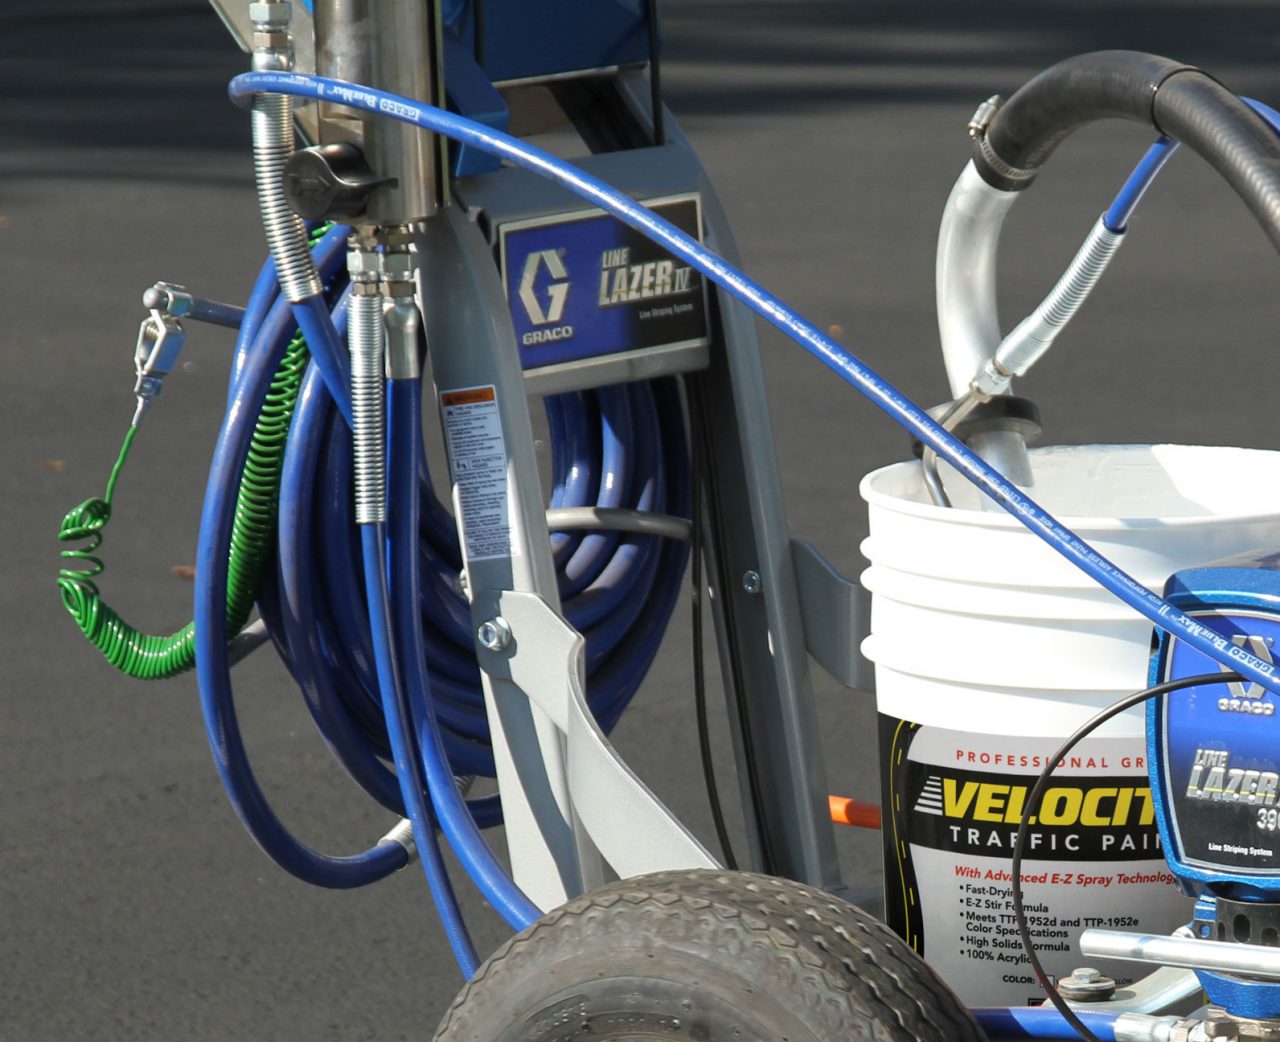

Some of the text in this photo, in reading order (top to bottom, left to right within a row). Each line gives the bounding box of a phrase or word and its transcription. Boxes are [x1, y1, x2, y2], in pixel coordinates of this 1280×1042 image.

[381, 100, 419, 119] GRACO
[602, 247, 630, 268] LINE
[599, 260, 674, 306] LAZER
[674, 266, 693, 293] IV
[522, 325, 574, 346] GRACO
[1231, 645, 1271, 676] GRACO
[1218, 698, 1275, 715] GRACO
[956, 750, 1145, 768] PROFESSIONAL GR
[1194, 748, 1229, 767] LINE
[1186, 765, 1280, 805] LAZER
[942, 777, 1156, 826] VELOCIT
[949, 825, 1160, 851] TRAFFIC PAI
[1208, 842, 1273, 857] Line Striping System
[954, 865, 982, 879] With
[1051, 873, 1073, 885] E-Z
[1076, 873, 1113, 887] Spray
[1117, 871, 1174, 884] Technolog
[966, 898, 1049, 913] E-Z Stir Fomula
[966, 911, 1139, 927] Meets TTP1952d and TTP-1952e
[966, 922, 1069, 939] Color Specications
[966, 936, 1071, 952] High Solids ormula
[967, 949, 995, 961] 100%
